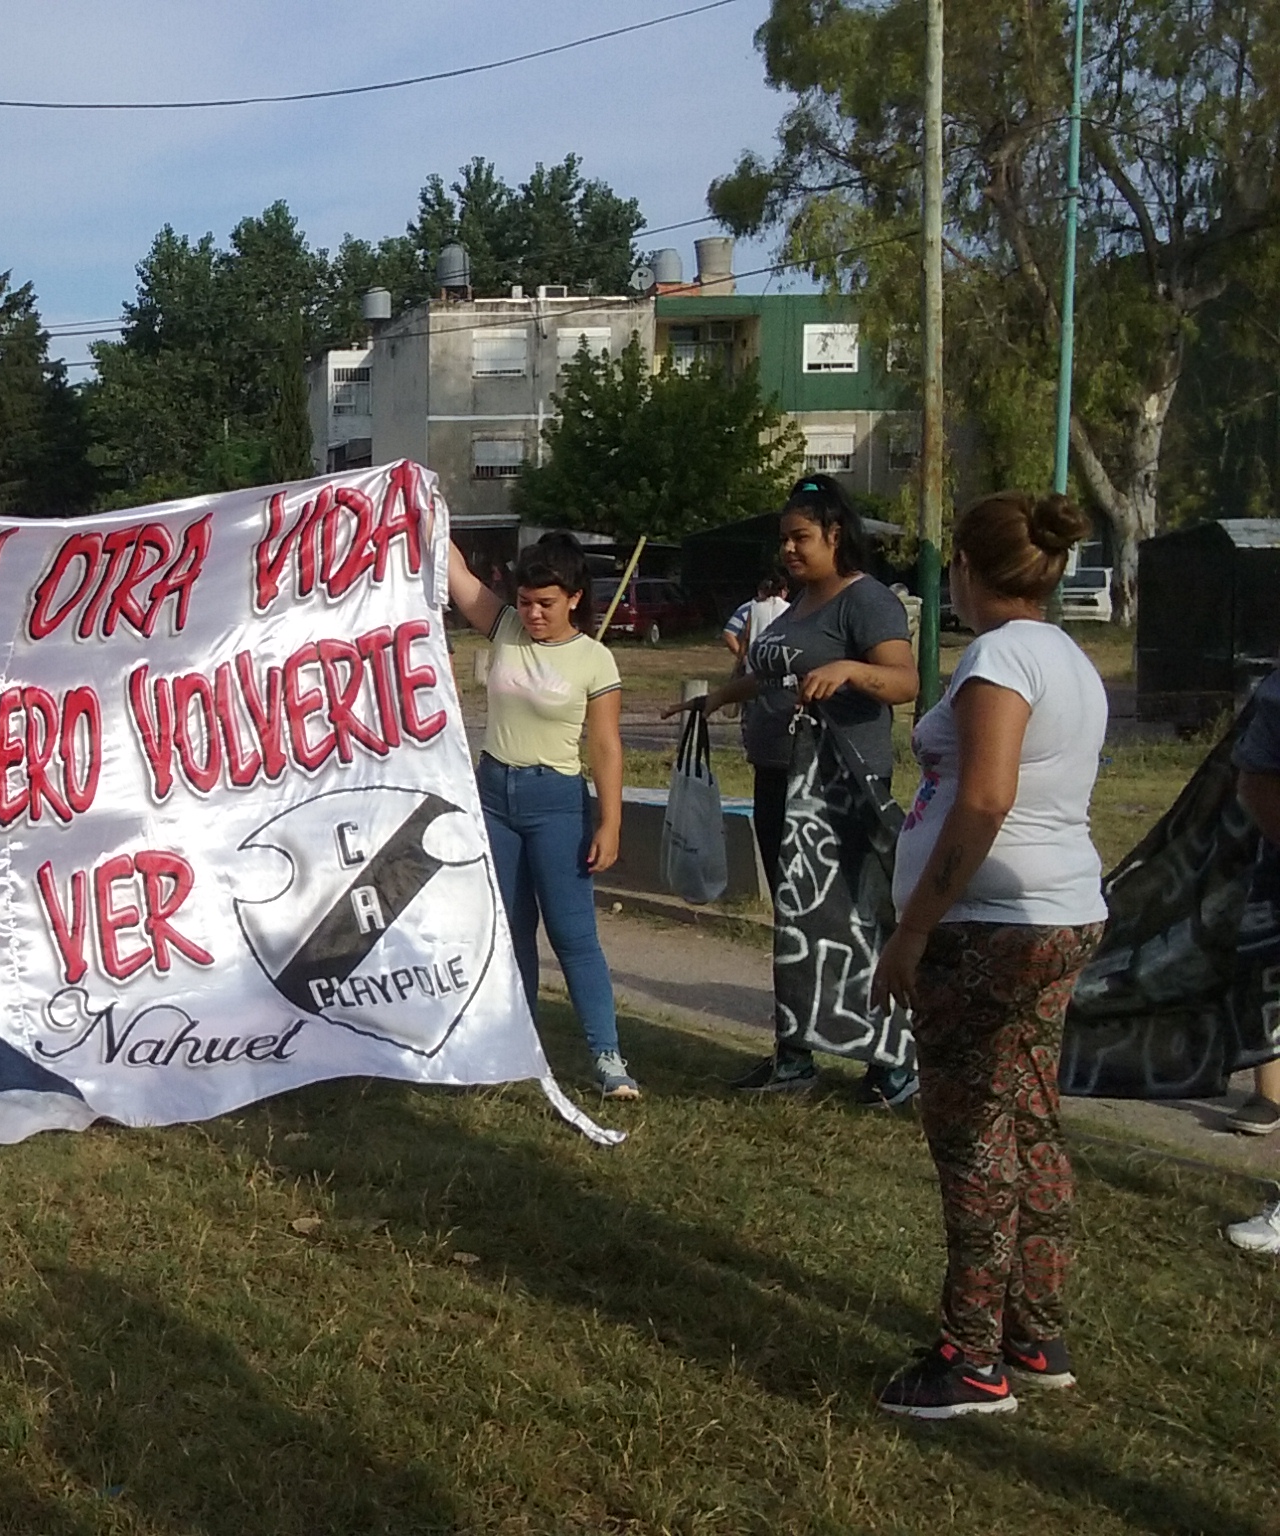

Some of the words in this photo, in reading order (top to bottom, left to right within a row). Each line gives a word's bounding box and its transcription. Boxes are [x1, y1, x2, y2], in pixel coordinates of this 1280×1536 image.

[30, 512, 215, 640] OTRA
[254, 460, 424, 613] VIDA
[127, 619, 448, 799] VOLVERTE
[335, 820, 365, 868] C
[38, 850, 215, 983] VER
[351, 885, 386, 935] A
[308, 954, 469, 1010] CLAYPOLE
[34, 986, 310, 1066] Nahuel
